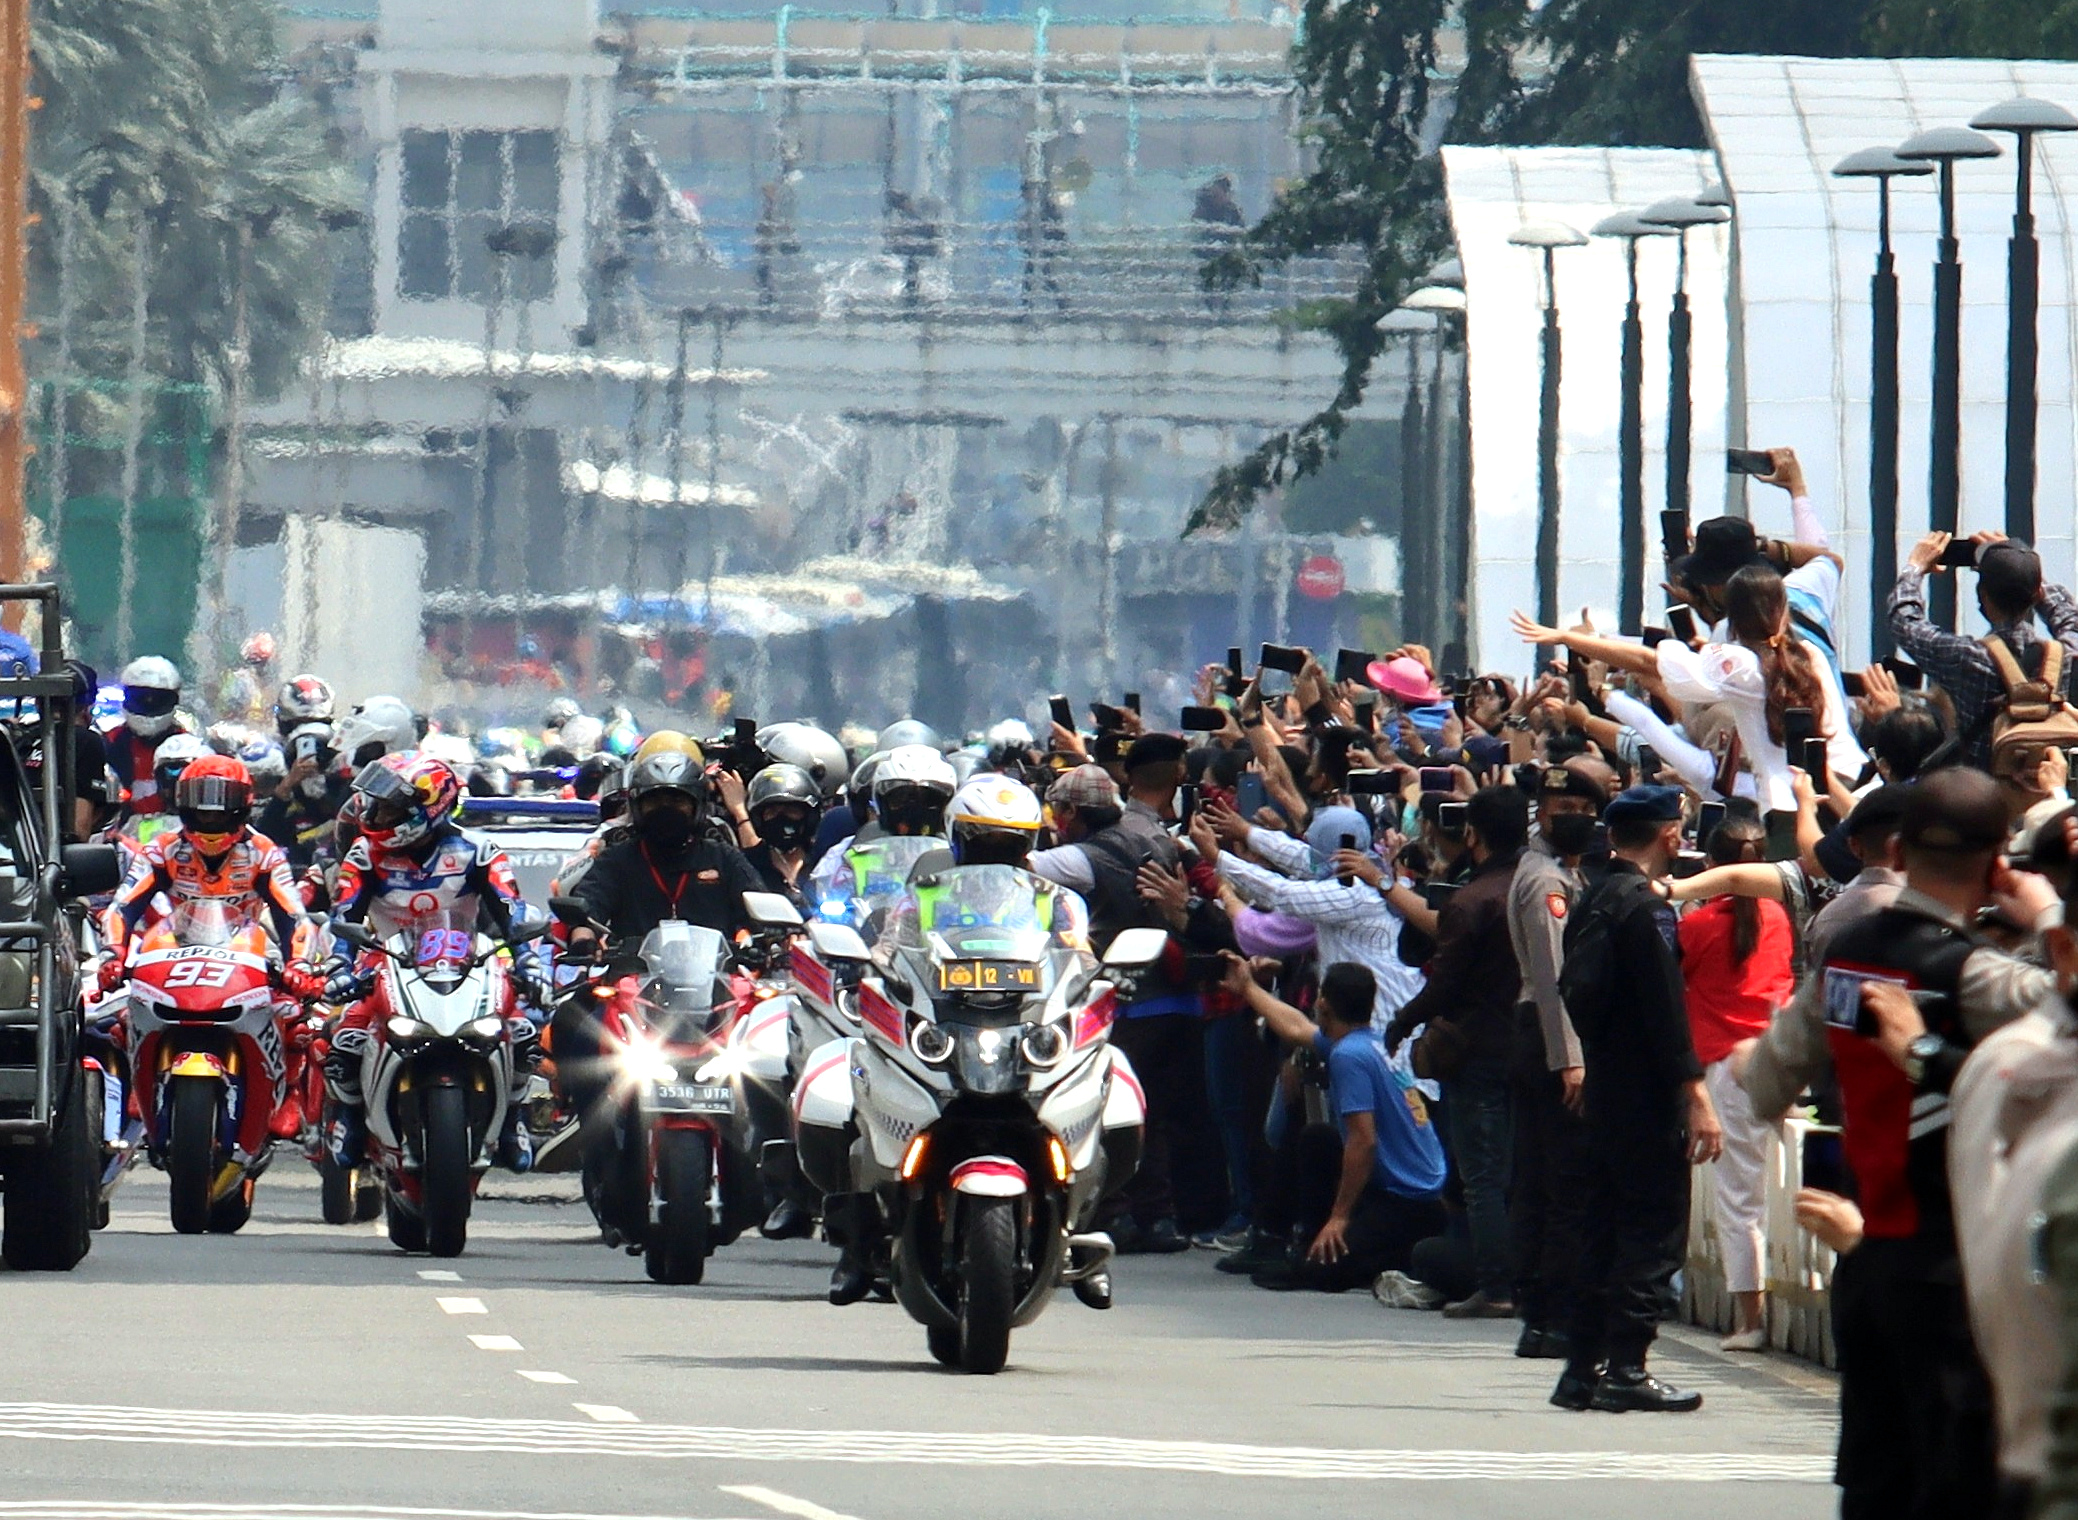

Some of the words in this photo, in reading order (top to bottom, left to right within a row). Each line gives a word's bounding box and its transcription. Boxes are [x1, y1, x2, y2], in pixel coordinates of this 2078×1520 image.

[166, 947, 238, 961] REPSOL
[164, 961, 236, 988] 93
[984, 967, 997, 984] 12
